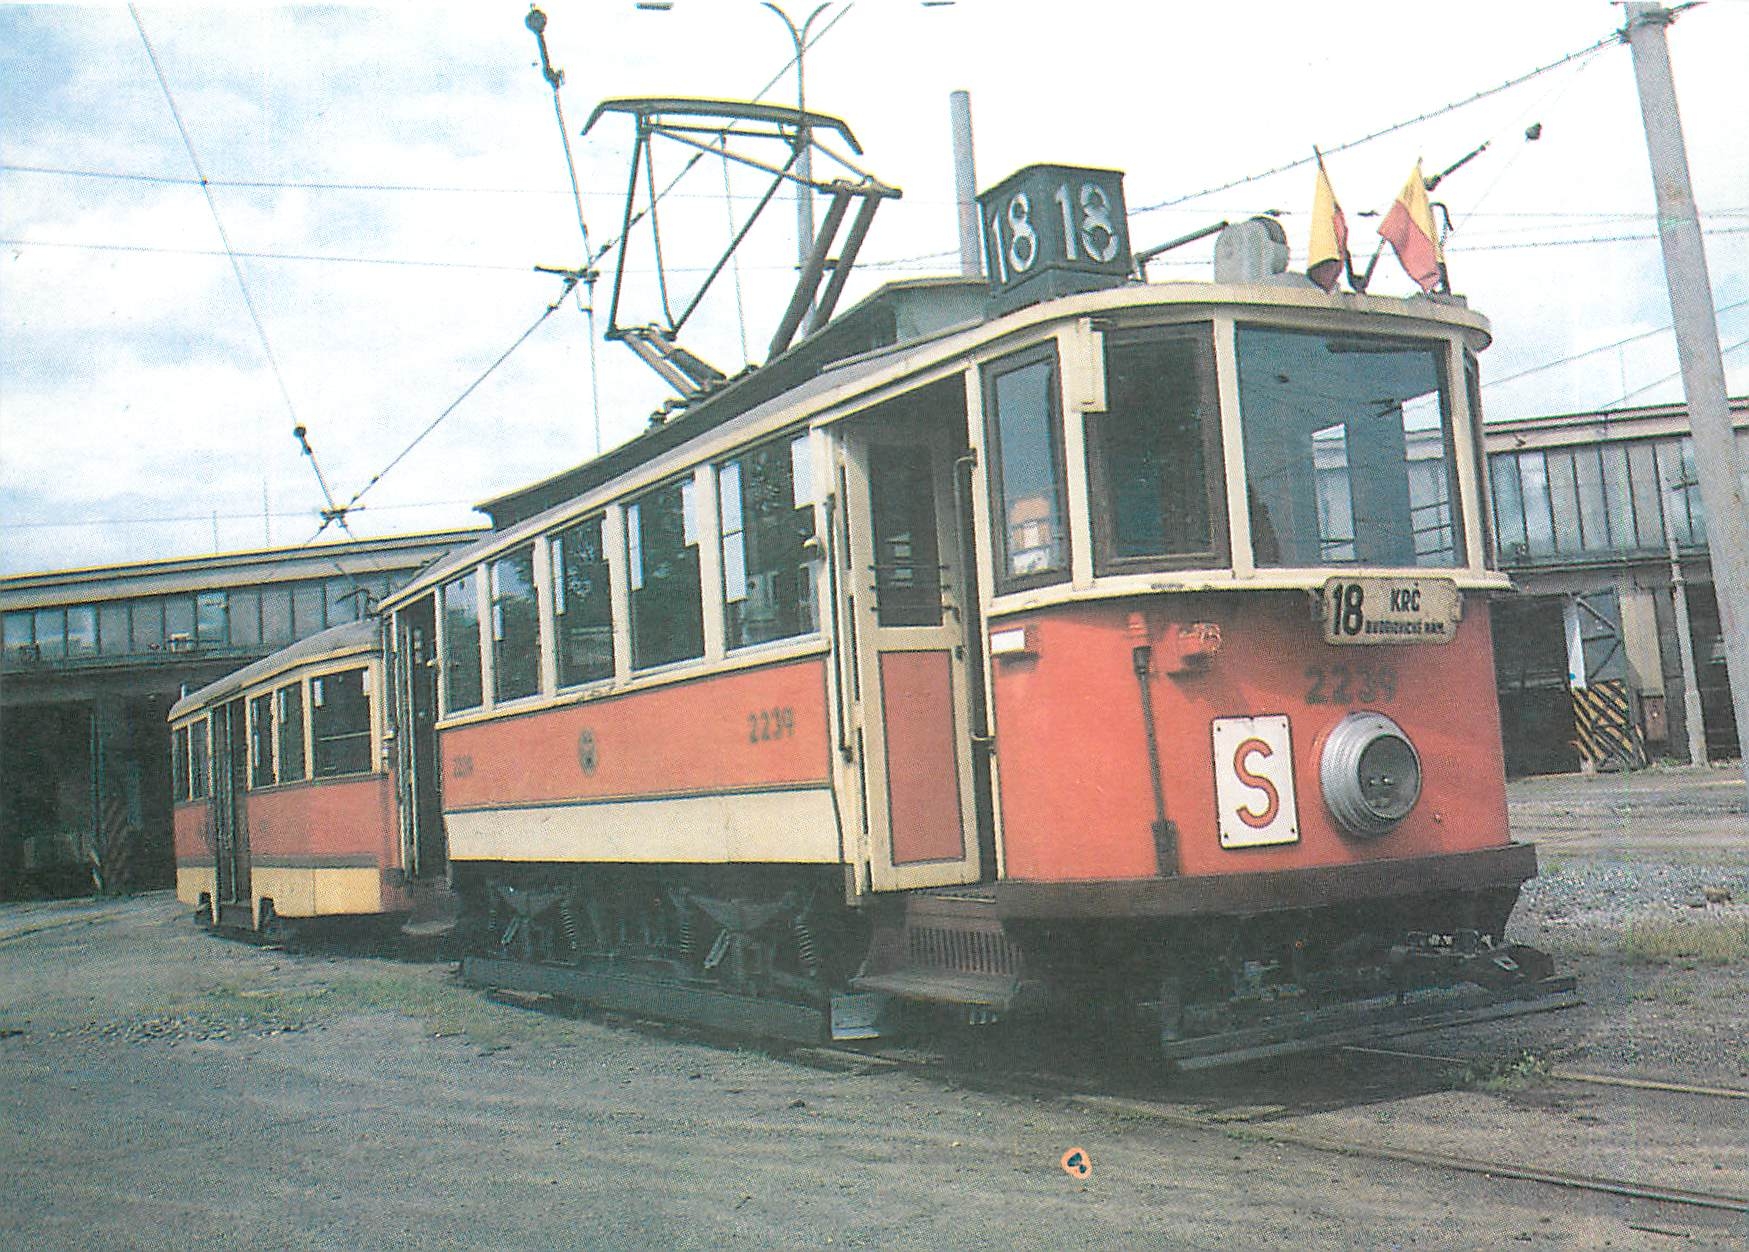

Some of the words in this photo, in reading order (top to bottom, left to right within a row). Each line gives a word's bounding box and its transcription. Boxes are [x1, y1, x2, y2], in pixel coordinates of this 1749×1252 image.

[992, 191, 1038, 285] 18
[1056, 182, 1120, 264] 18
[1333, 583, 1364, 636] 18
[1304, 664, 1398, 705] 2239
[747, 706, 795, 744] 2239
[1233, 738, 1280, 829] S
